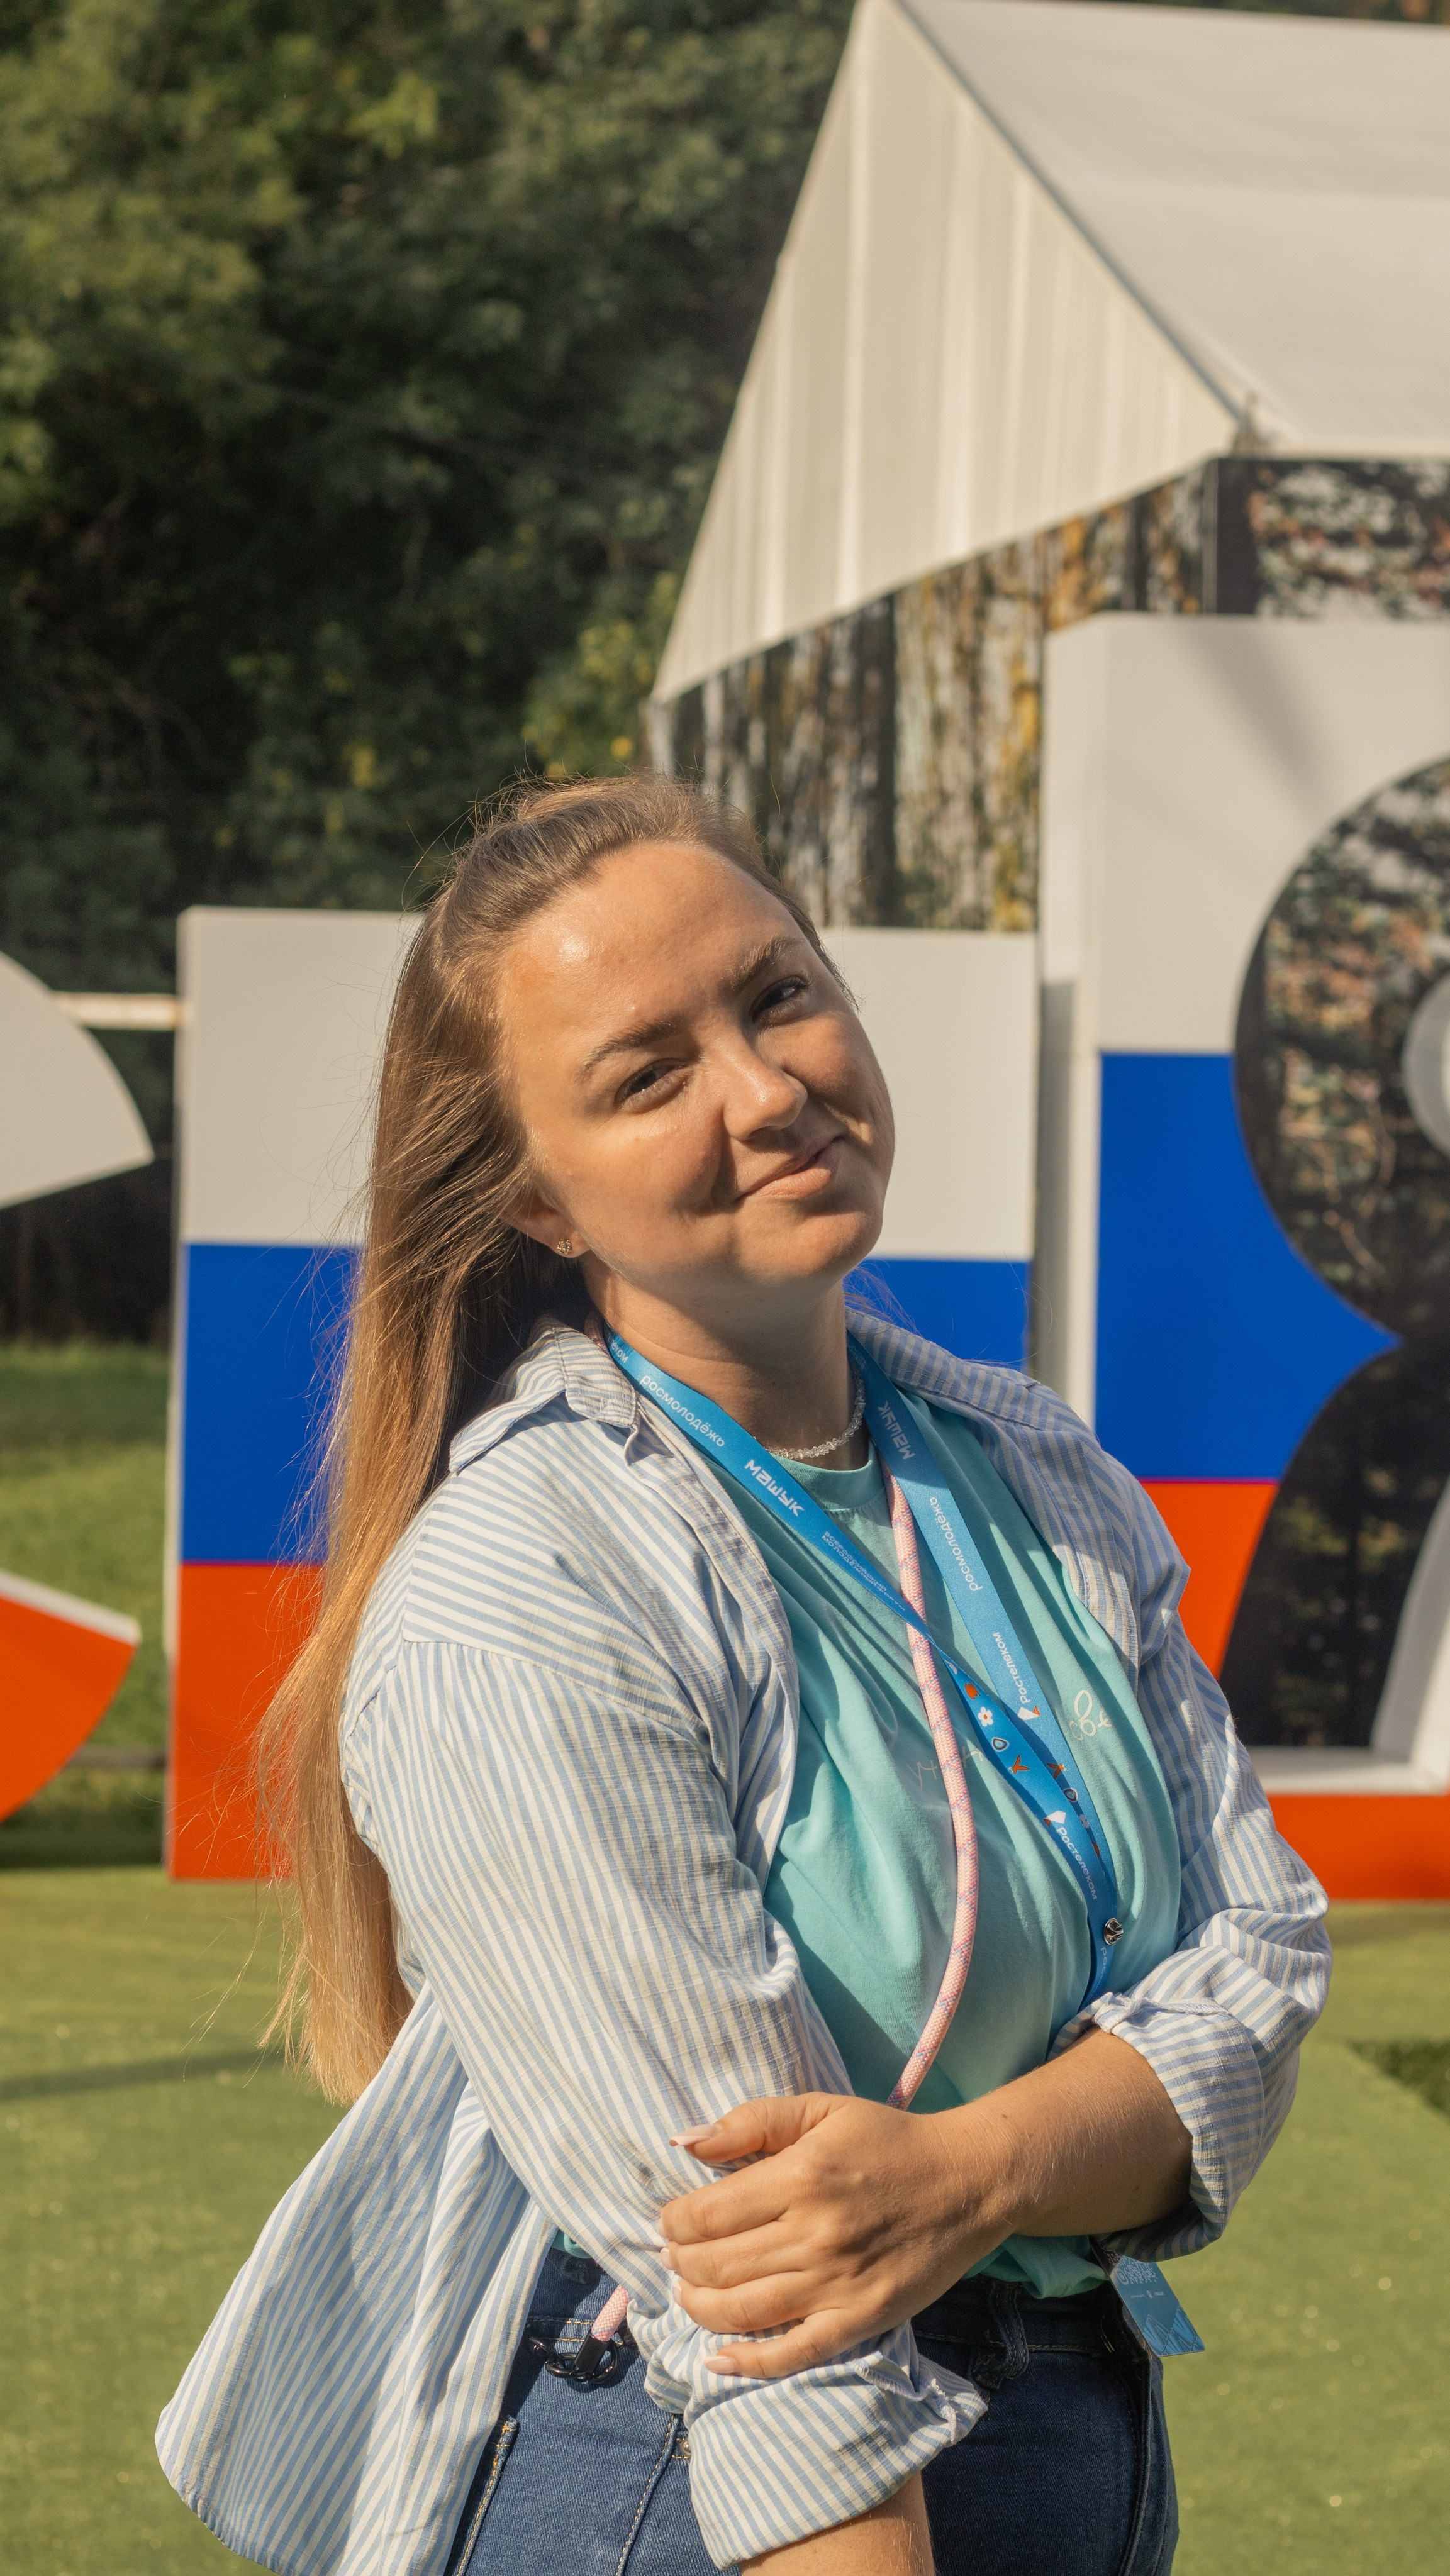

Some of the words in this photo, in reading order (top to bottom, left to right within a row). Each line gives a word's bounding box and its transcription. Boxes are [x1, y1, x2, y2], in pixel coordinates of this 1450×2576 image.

[639, 1375, 725, 1447] росмолодёжь
[929, 1496, 983, 1591] росмолодёжь
[992, 1631, 1031, 1705] Ростелеком
[1056, 1826, 1098, 1900] Ростелеком
